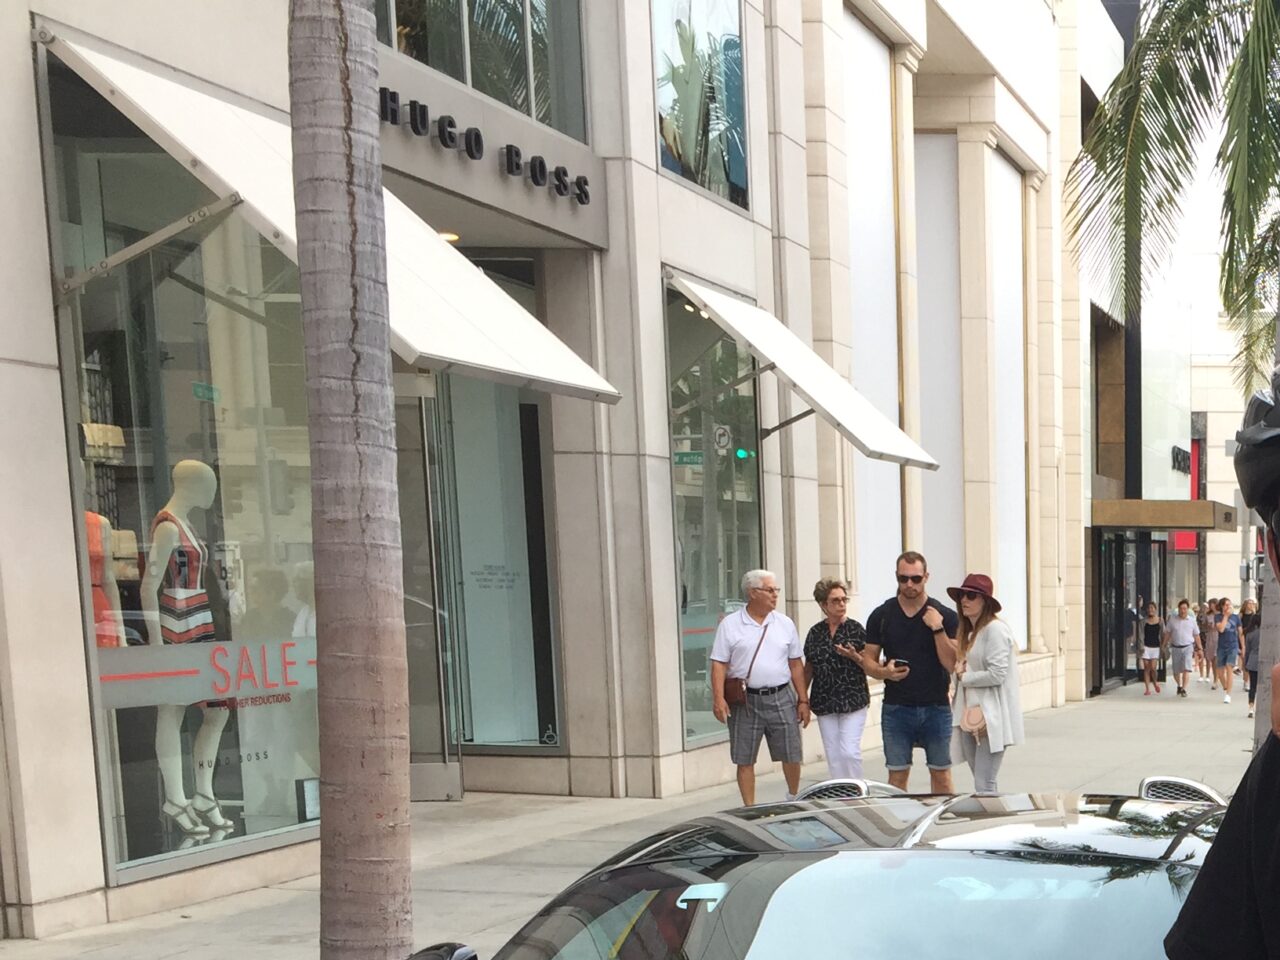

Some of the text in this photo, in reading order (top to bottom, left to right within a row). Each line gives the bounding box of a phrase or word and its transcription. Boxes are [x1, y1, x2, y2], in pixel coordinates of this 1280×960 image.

[379, 87, 590, 205] HUGO BOSS
[210, 642, 298, 694] SALE
[198, 756, 230, 769] HUO
